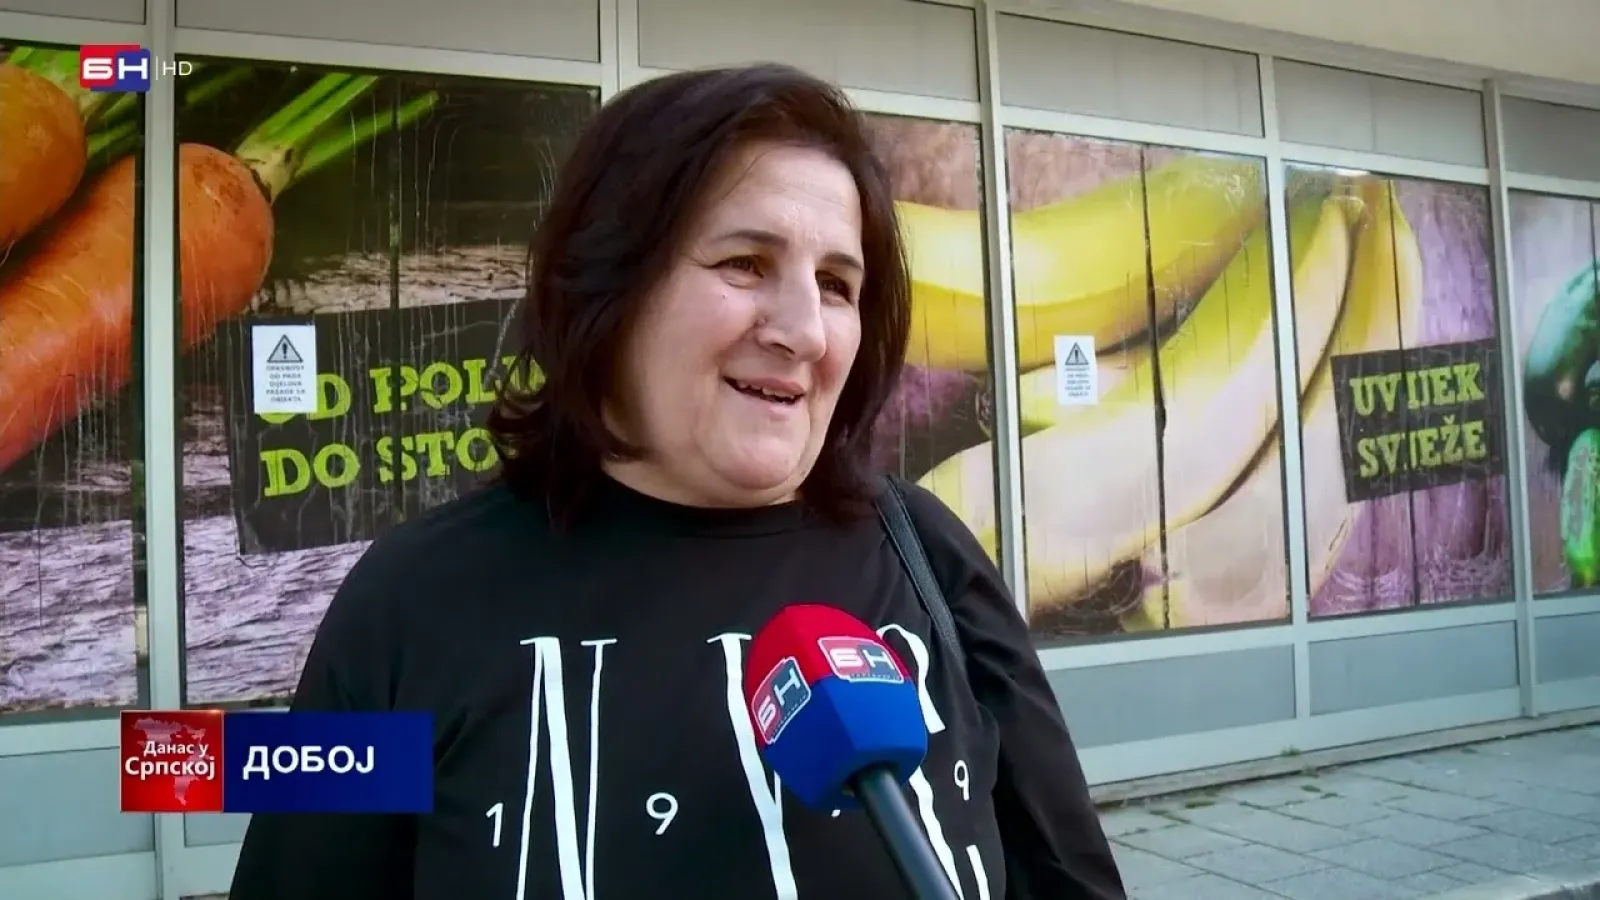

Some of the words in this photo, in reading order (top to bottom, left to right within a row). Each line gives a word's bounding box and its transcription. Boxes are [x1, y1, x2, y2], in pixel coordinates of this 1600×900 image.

[258, 372, 351, 424] D
[1350, 362, 1485, 416] UVIJEK
[260, 443, 361, 496] DO
